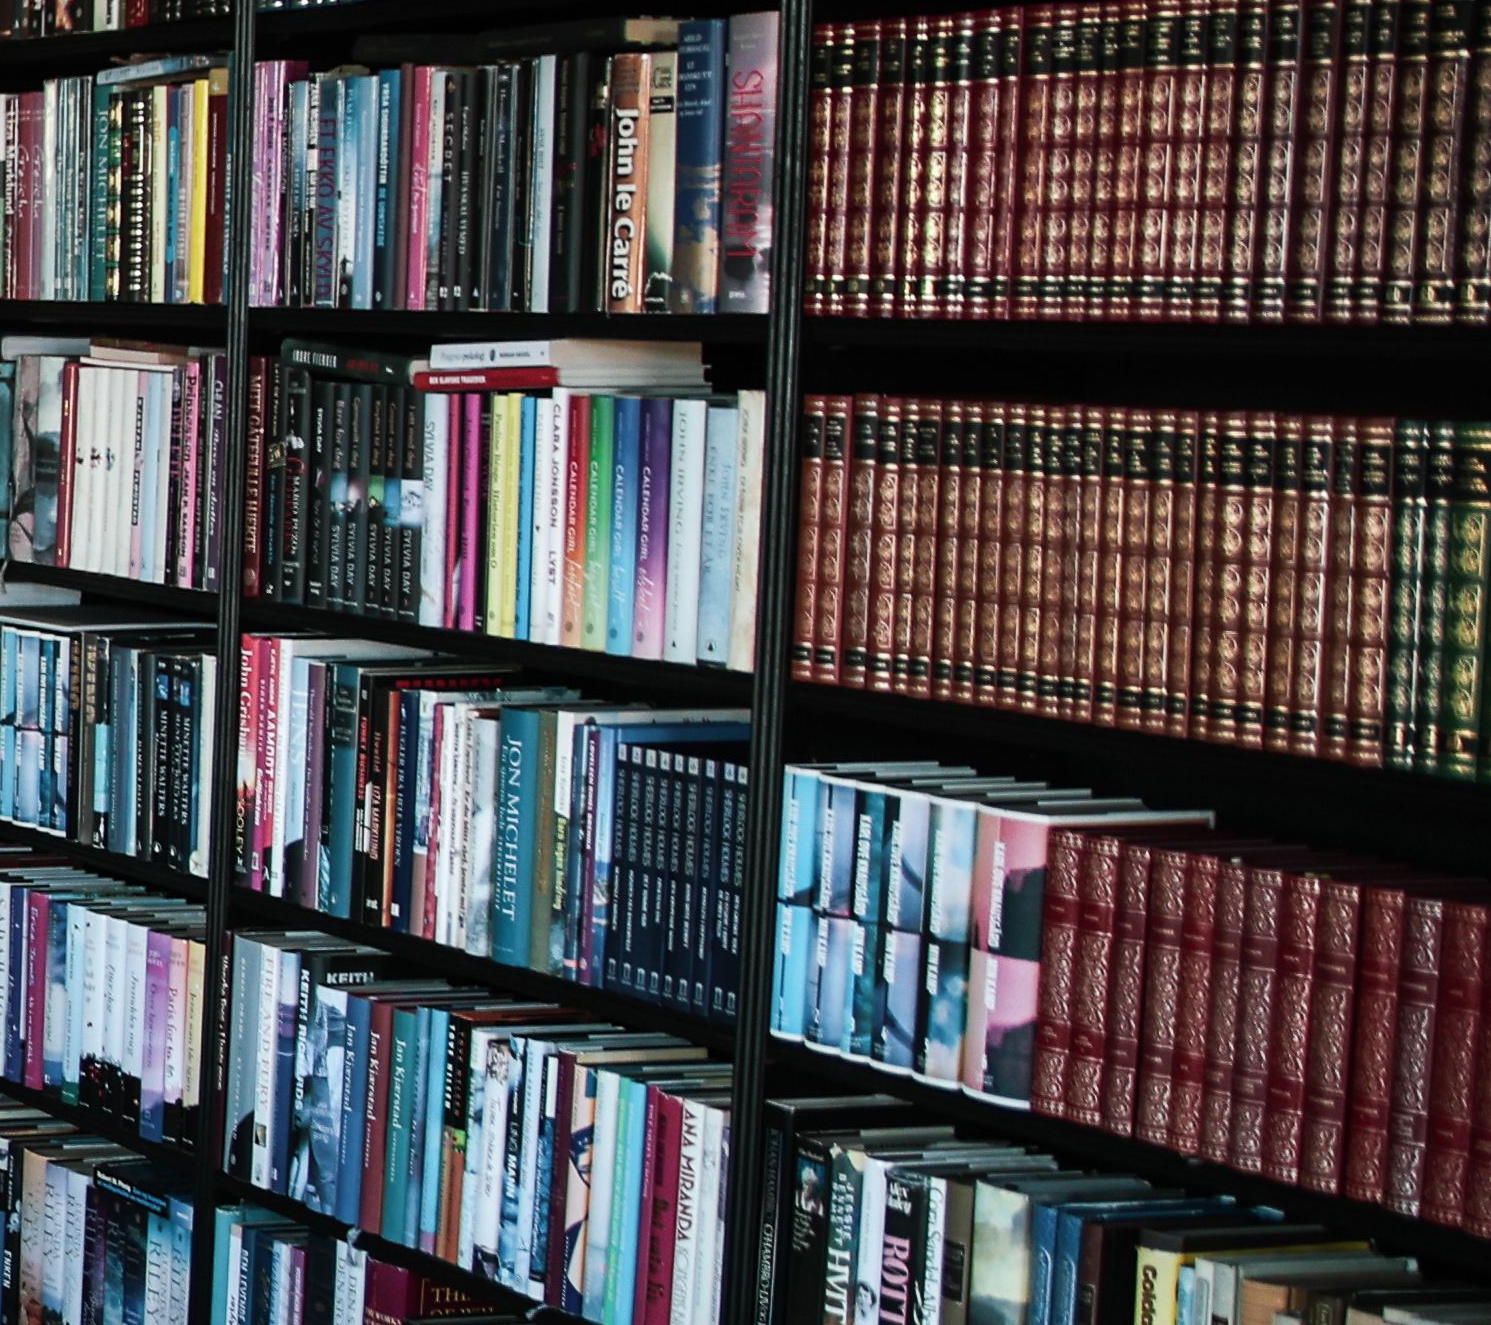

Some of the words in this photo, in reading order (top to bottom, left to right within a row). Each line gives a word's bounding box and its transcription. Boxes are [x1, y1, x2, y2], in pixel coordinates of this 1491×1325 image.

[616, 109, 639, 175] John
[317, 147, 335, 197] EKKO
[726, 69, 764, 258] SHANTARAM
[615, 184, 636, 211] le
[316, 205, 333, 229] AV
[316, 235, 333, 297] SKYLD
[611, 218, 635, 298] Carré
[247, 375, 261, 414] MITT
[551, 404, 561, 453] CLARA
[567, 461, 578, 525] CALENDAR
[589, 461, 599, 525] CALENDAR
[614, 464, 624, 529] CALENDAR
[641, 465, 651, 531] CALENDAR
[244, 500, 258, 553] HJERTE
[330, 525, 339, 562] SYLVIA
[346, 522, 356, 560] SYLVIA
[368, 523, 377, 561] SYLVIA
[383, 527, 392, 564] SYLVIA
[566, 528, 576, 554] GIRL
[588, 528, 597, 554] GIRL
[613, 532, 623, 559] GIRL
[402, 530, 412, 567] SYLVIA
[639, 534, 649, 561] GIRL
[329, 565, 339, 587] DAY
[345, 563, 355, 589] DAY
[368, 563, 377, 586] DAY
[382, 566, 392, 590] DAY
[402, 570, 411, 594] DAY
[548, 551, 556, 585] LYST
[506, 736, 522, 787] JON
[501, 793, 521, 922] MICHELET
[925, 965, 939, 996] KAMP
[985, 978, 997, 1011] KAMP
[345, 1023, 356, 1047] Jan
[368, 1031, 380, 1055] Jan
[394, 1039, 407, 1063] Jan
[343, 1050, 355, 1112] Kjærstad
[366, 1057, 380, 1121] Kjærstad
[391, 1066, 406, 1129] Kjærstad
[682, 1109, 697, 1148] ANA
[676, 1155, 694, 1242] MIRANDA
[147, 1240, 162, 1322] RILEY
[825, 1248, 850, 1325] HVIT
